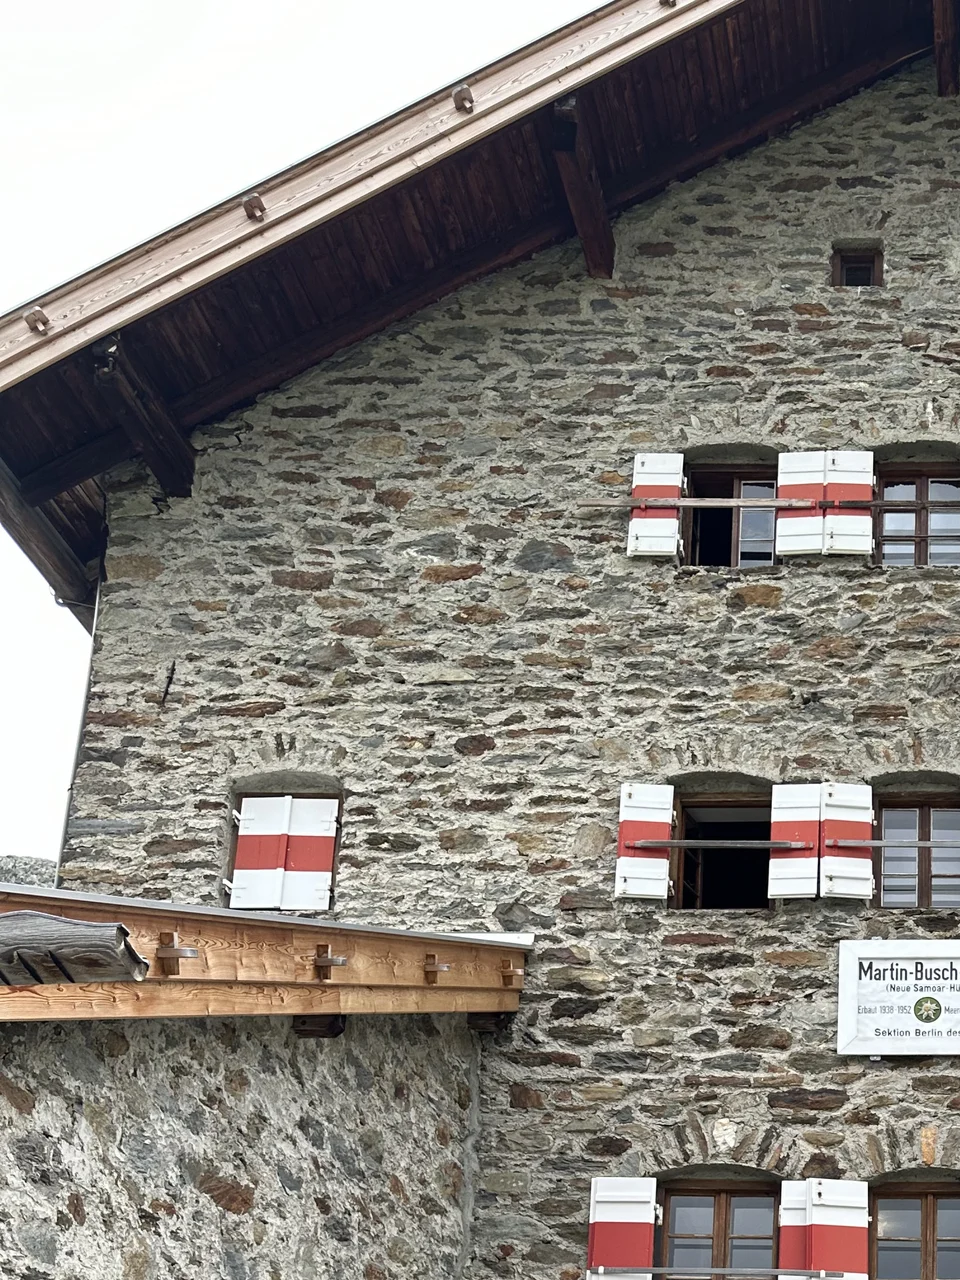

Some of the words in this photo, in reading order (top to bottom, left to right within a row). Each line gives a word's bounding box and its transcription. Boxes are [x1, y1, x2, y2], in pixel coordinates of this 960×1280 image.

[886, 983, 911, 993] (Neue
[857, 1005, 878, 1015] Erbaut
[874, 1027, 911, 1037] Sektion
[914, 1027, 943, 1037] Berlin
